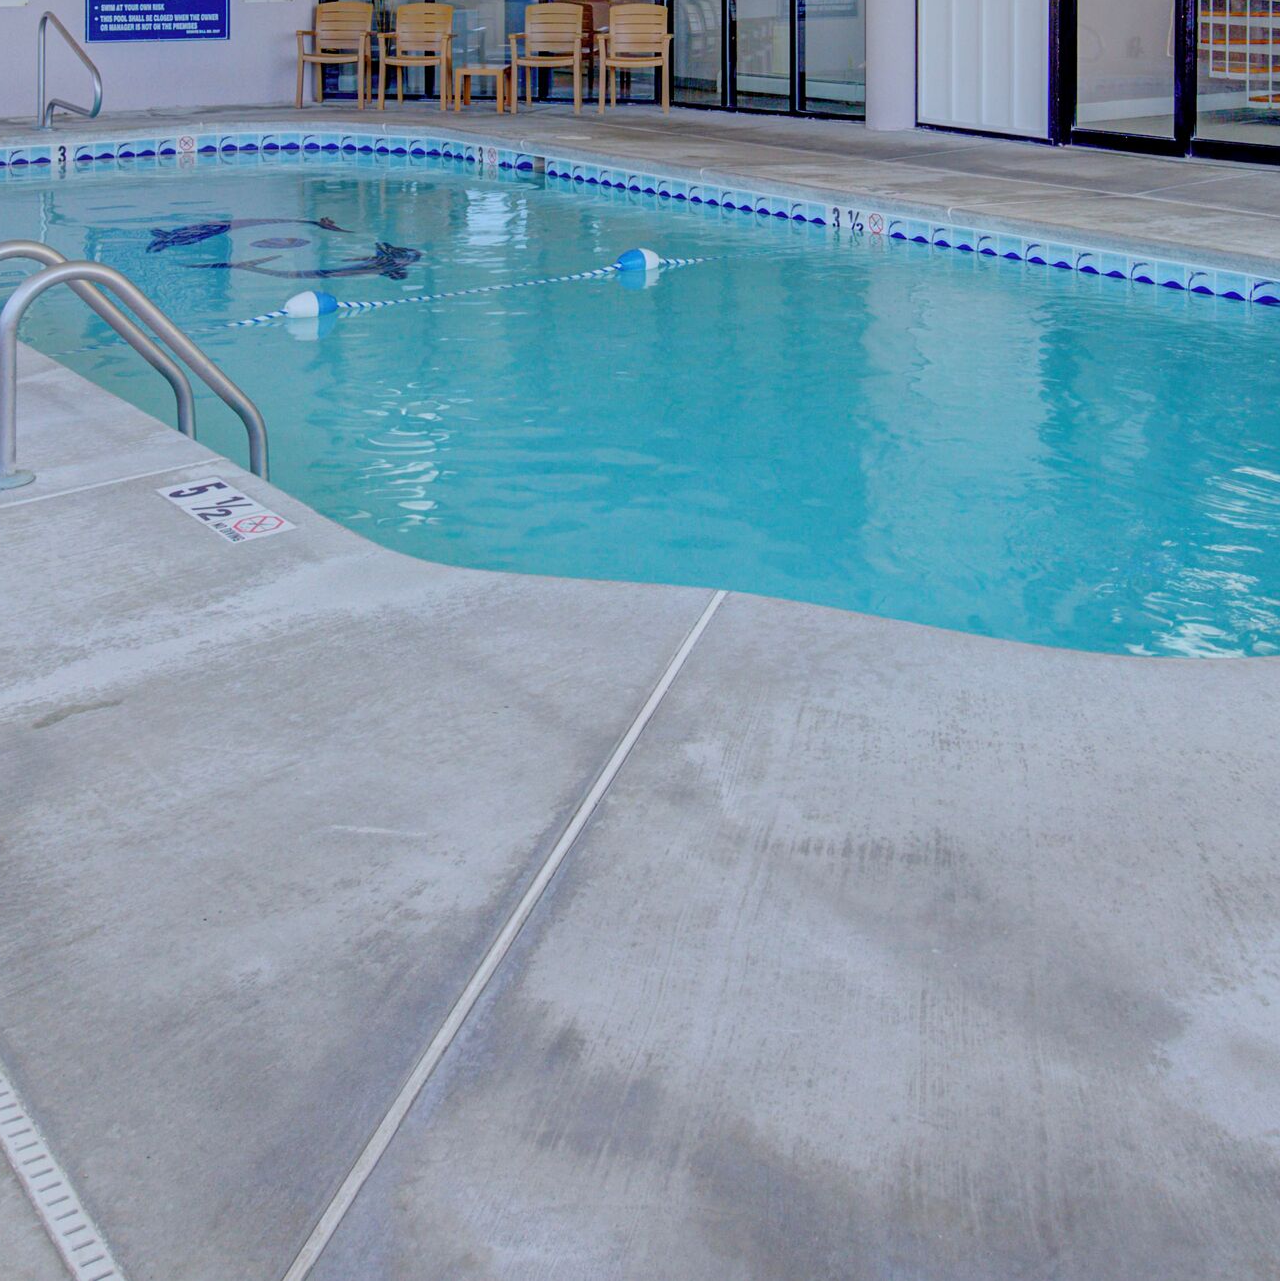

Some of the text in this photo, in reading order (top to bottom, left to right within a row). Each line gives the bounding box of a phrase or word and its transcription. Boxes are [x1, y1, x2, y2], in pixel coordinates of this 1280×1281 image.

[58, 146, 67, 162] 3
[479, 146, 483, 165] 3
[832, 207, 840, 227] 3
[168, 481, 228, 498] 5
